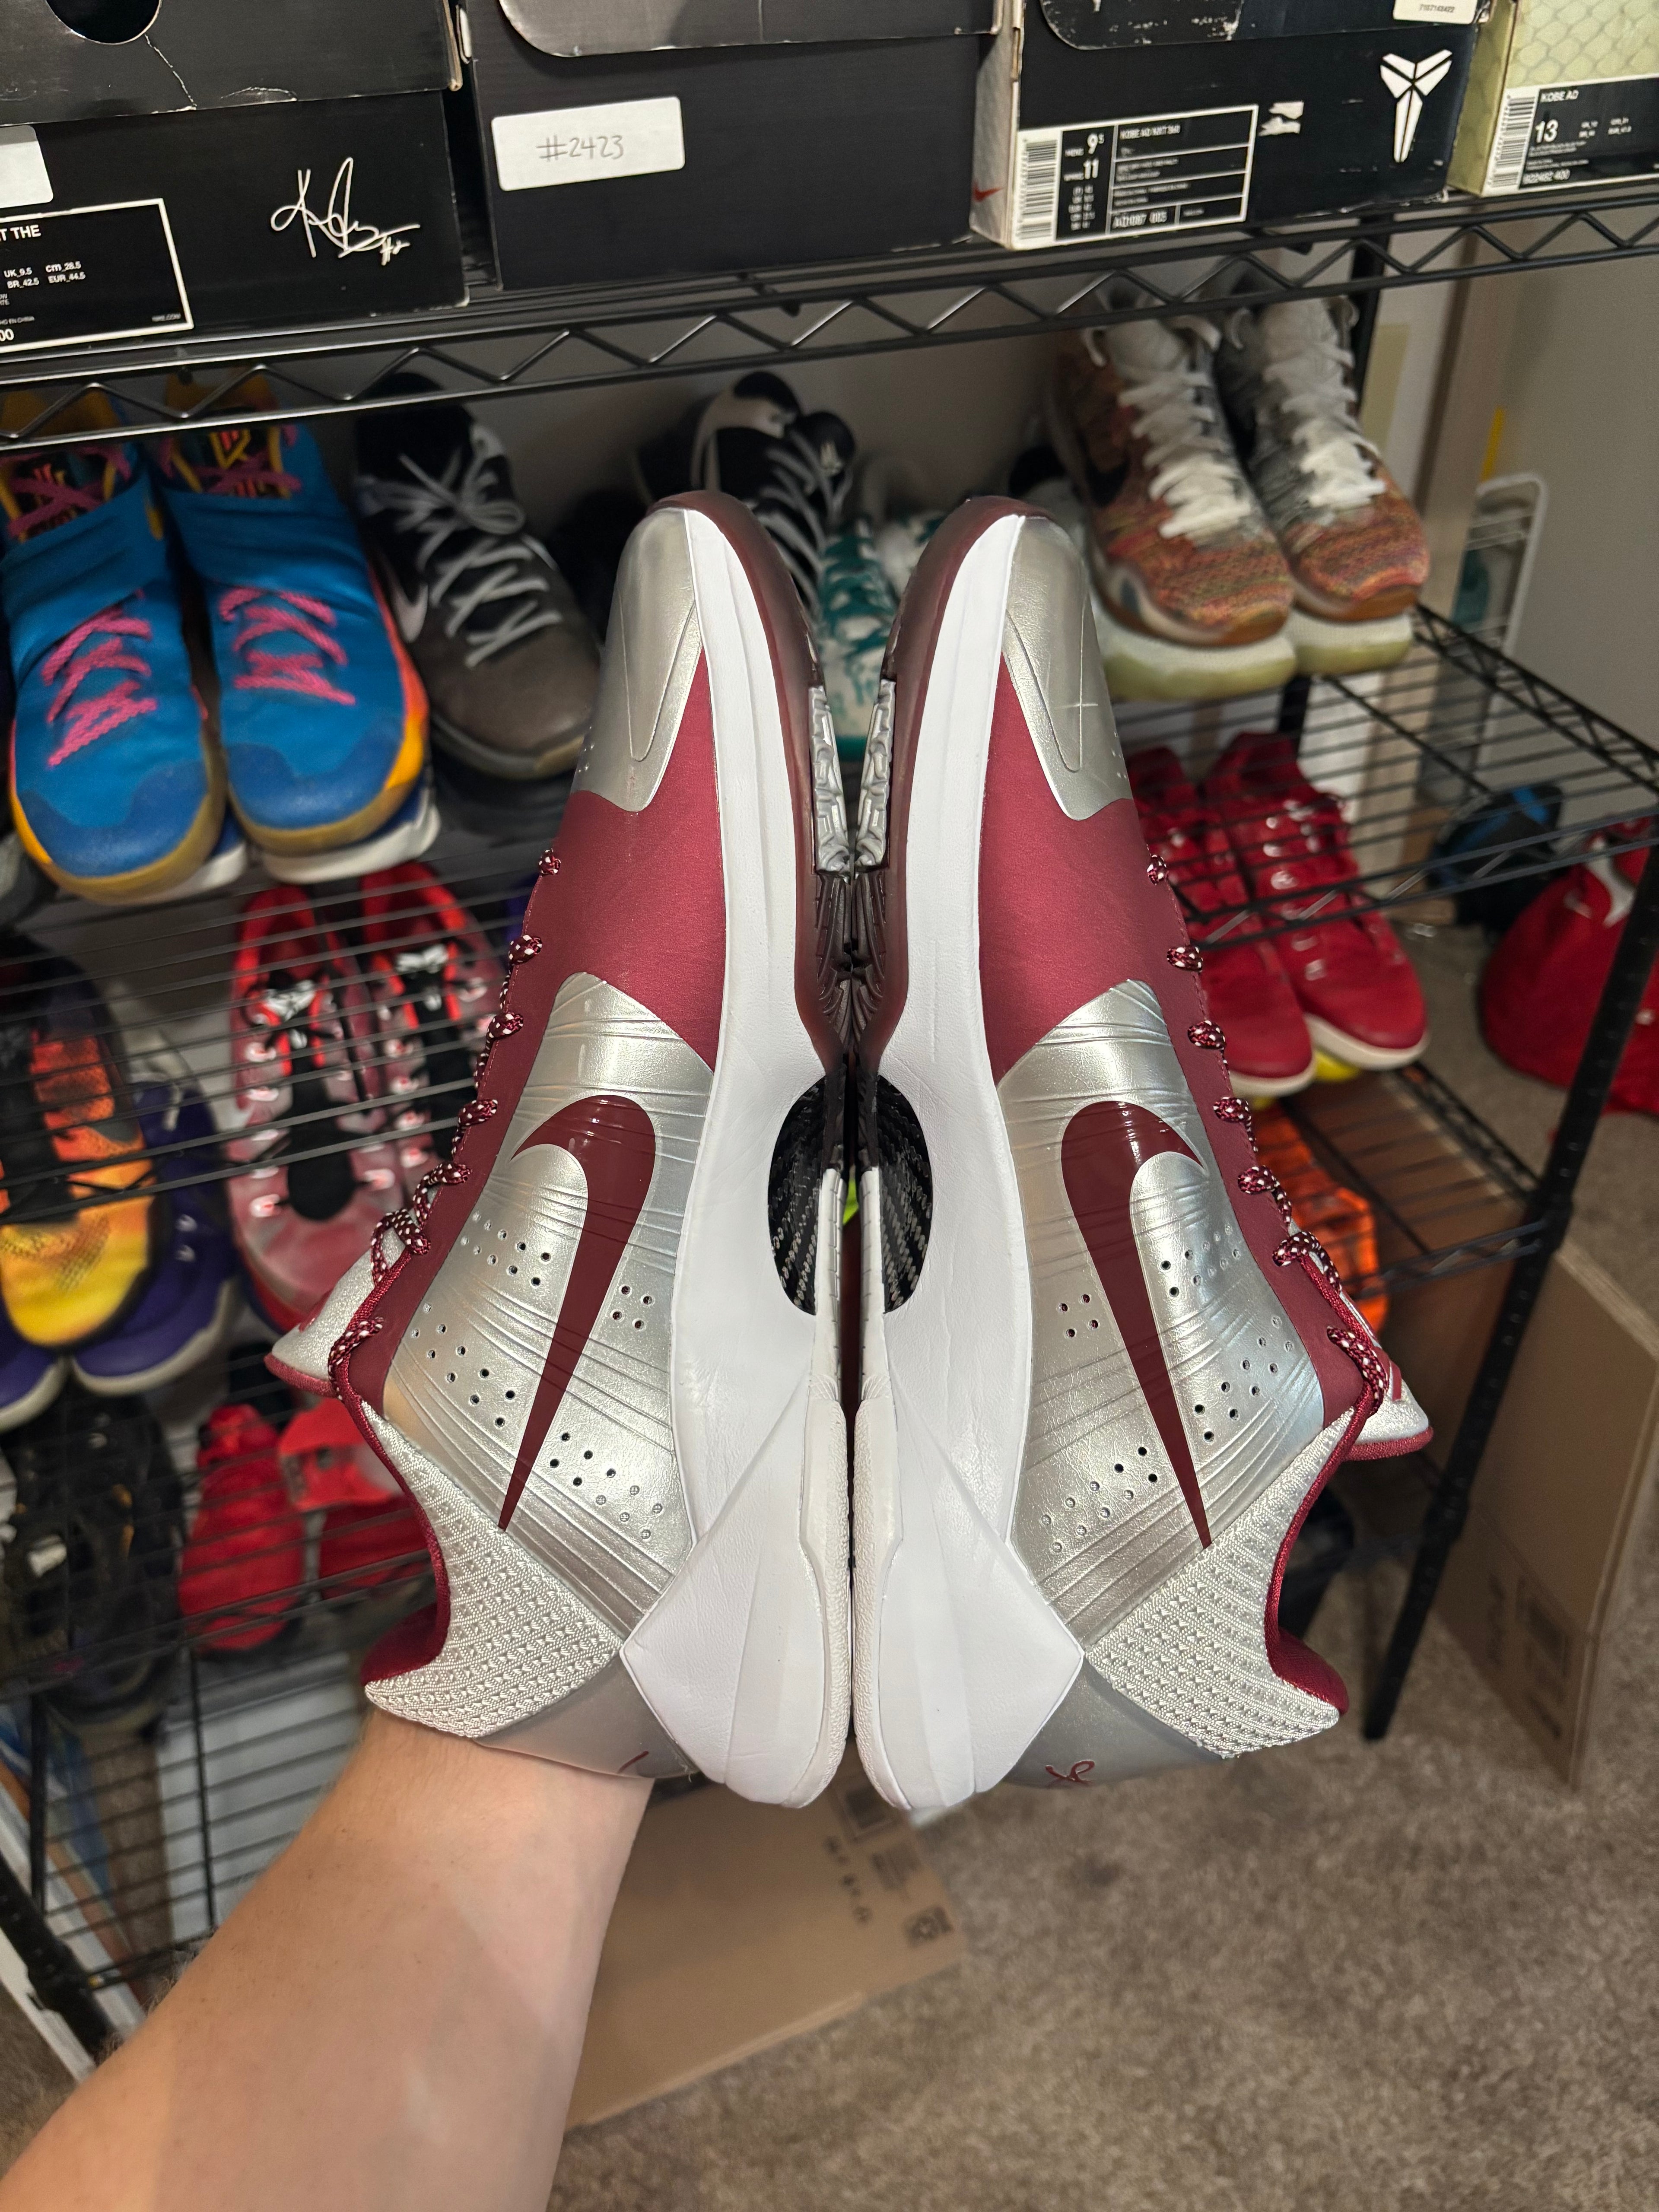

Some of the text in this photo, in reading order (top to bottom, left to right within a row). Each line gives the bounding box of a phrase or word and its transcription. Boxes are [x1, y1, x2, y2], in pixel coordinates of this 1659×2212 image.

[1540, 89, 1579, 103] KOBE AD
[1535, 119, 1559, 143] 13
[1083, 158, 1099, 180] 11
[10, 224, 41, 239] THE
